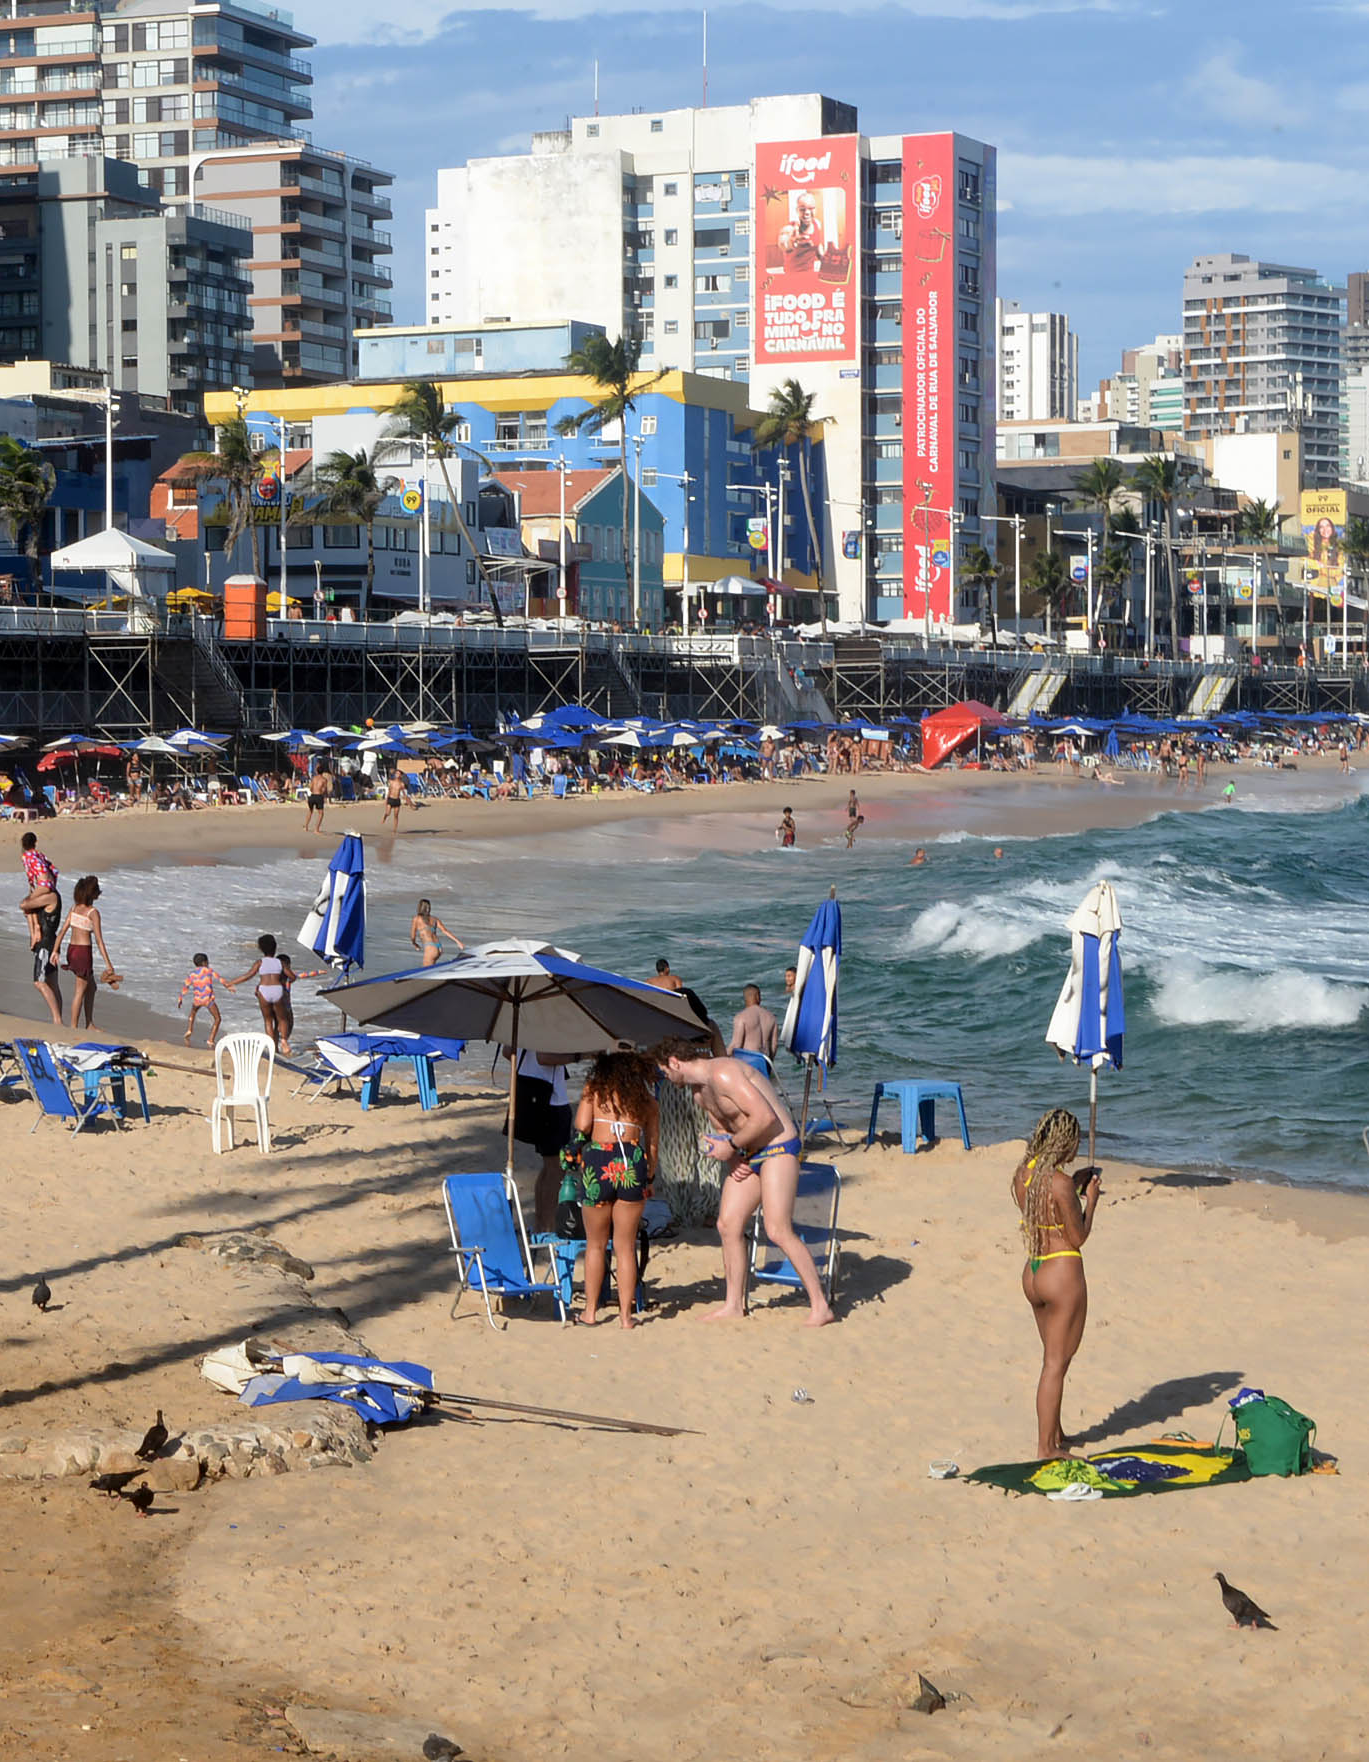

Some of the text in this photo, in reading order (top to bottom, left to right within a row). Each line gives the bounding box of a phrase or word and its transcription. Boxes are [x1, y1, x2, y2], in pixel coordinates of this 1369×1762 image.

[764, 293, 826, 311] iFOOD
[764, 309, 845, 325] TUDO PRA
[764, 322, 845, 338] MIM NO
[764, 336, 846, 353] CARNAVAL
[916, 307, 926, 456] PATROCINADOR OFICIAL DO
[928, 290, 938, 472] CARNAVAL DE RUA DE SALVADOR
